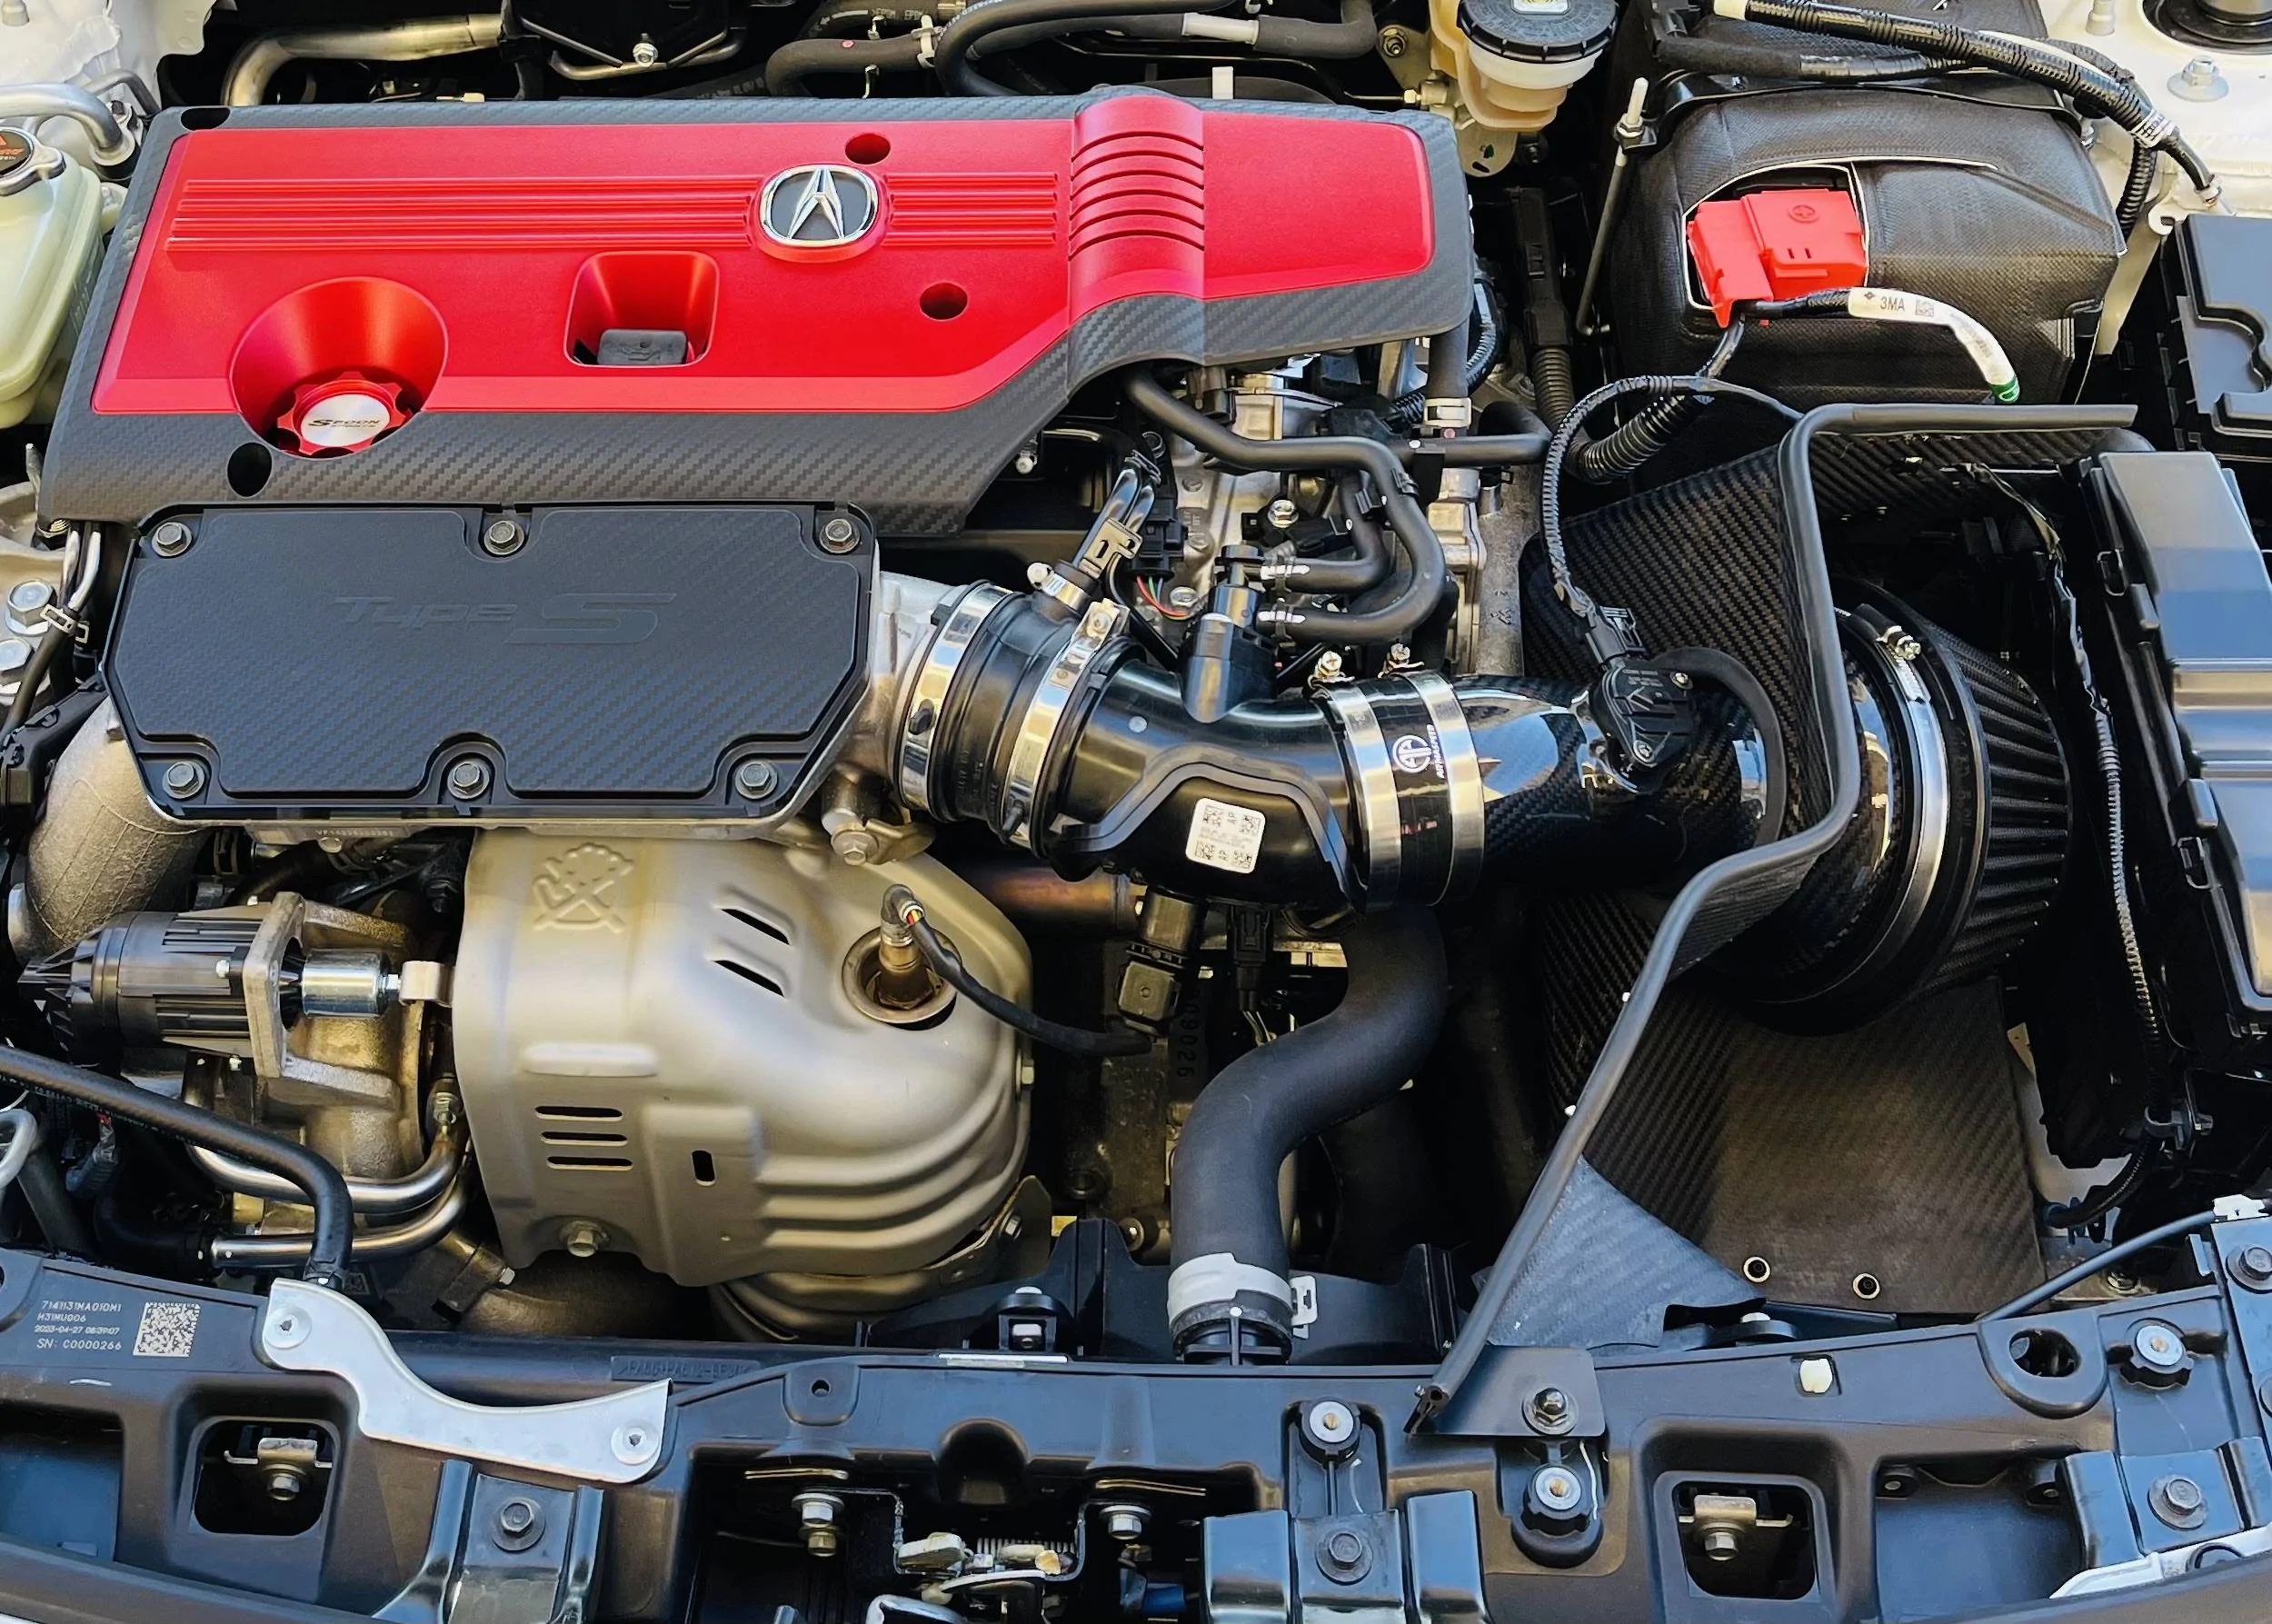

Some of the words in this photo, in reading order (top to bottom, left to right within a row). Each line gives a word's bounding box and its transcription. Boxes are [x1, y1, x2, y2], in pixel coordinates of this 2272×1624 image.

[1879, 295, 1905, 312] 3MA
[502, 593, 677, 644] S
[36, 1338, 58, 1350] SN:
